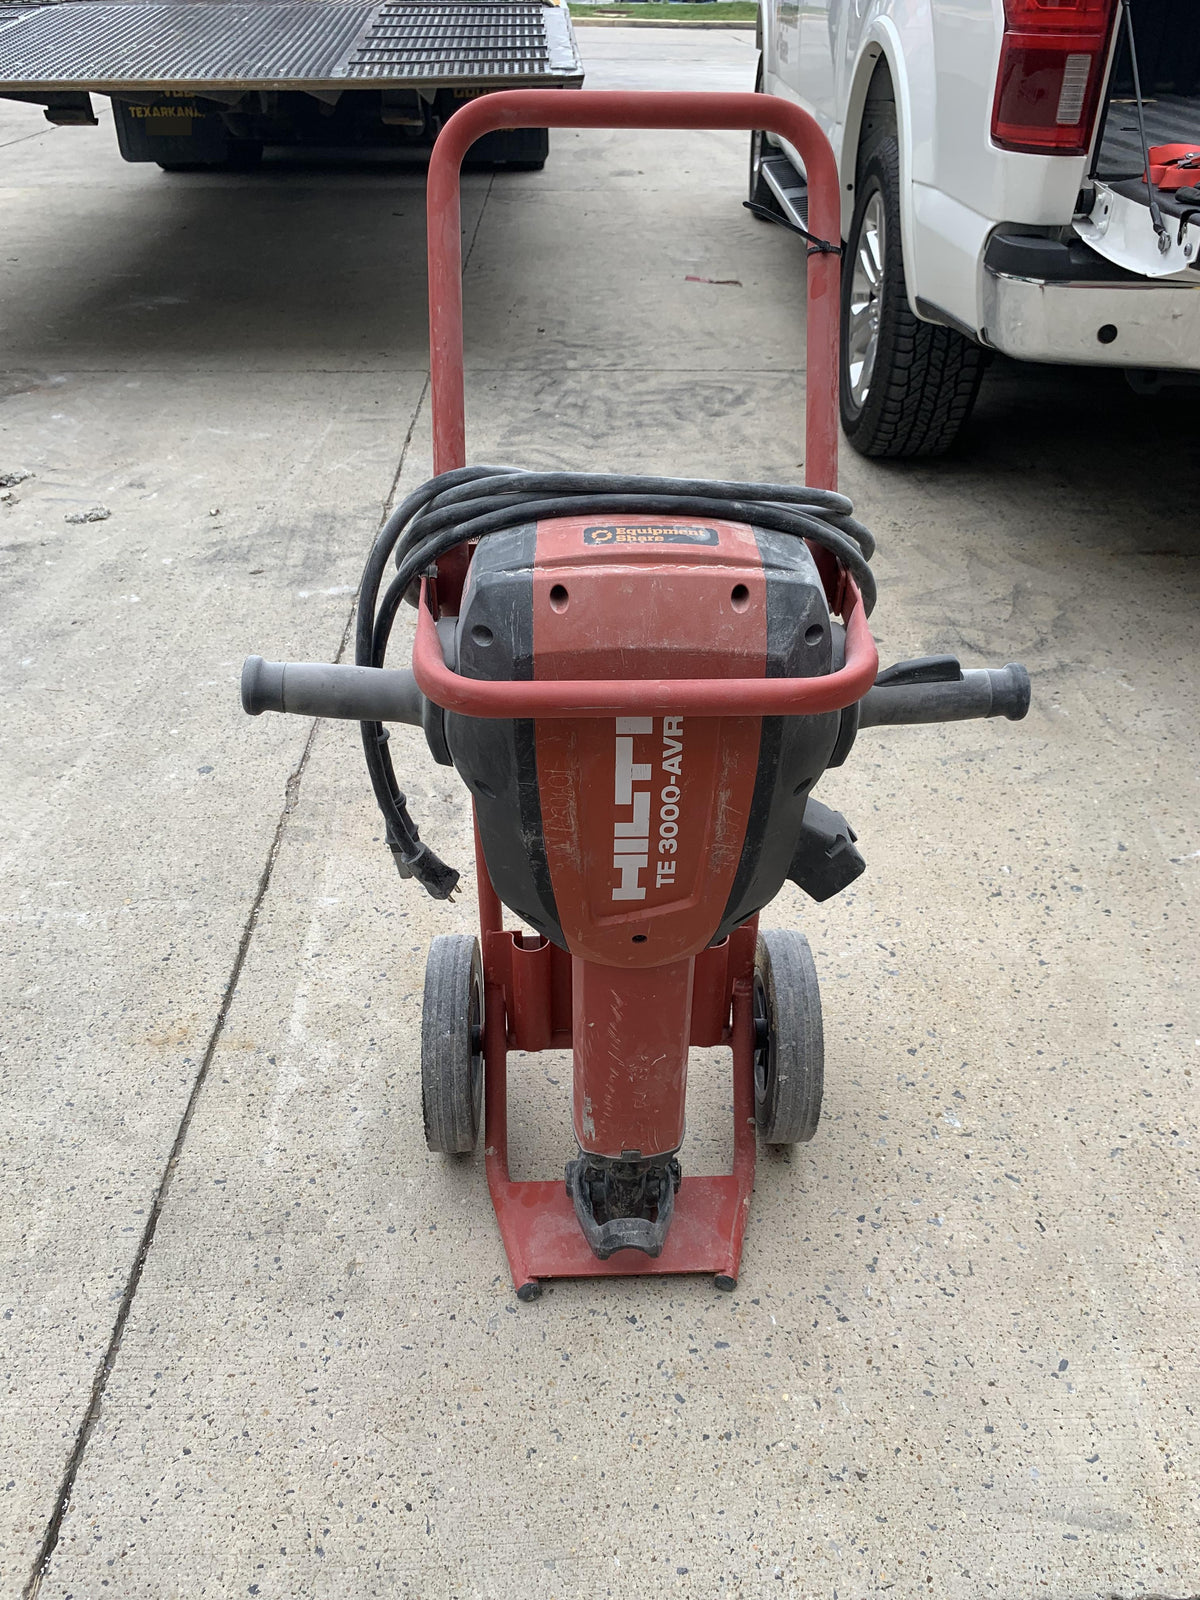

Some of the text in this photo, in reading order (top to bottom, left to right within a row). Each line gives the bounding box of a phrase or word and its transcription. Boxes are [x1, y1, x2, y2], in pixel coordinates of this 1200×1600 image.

[615, 527, 706, 537] Equipment
[612, 716, 653, 900] HILTI
[656, 715, 684, 888] TE 3000-AVR
